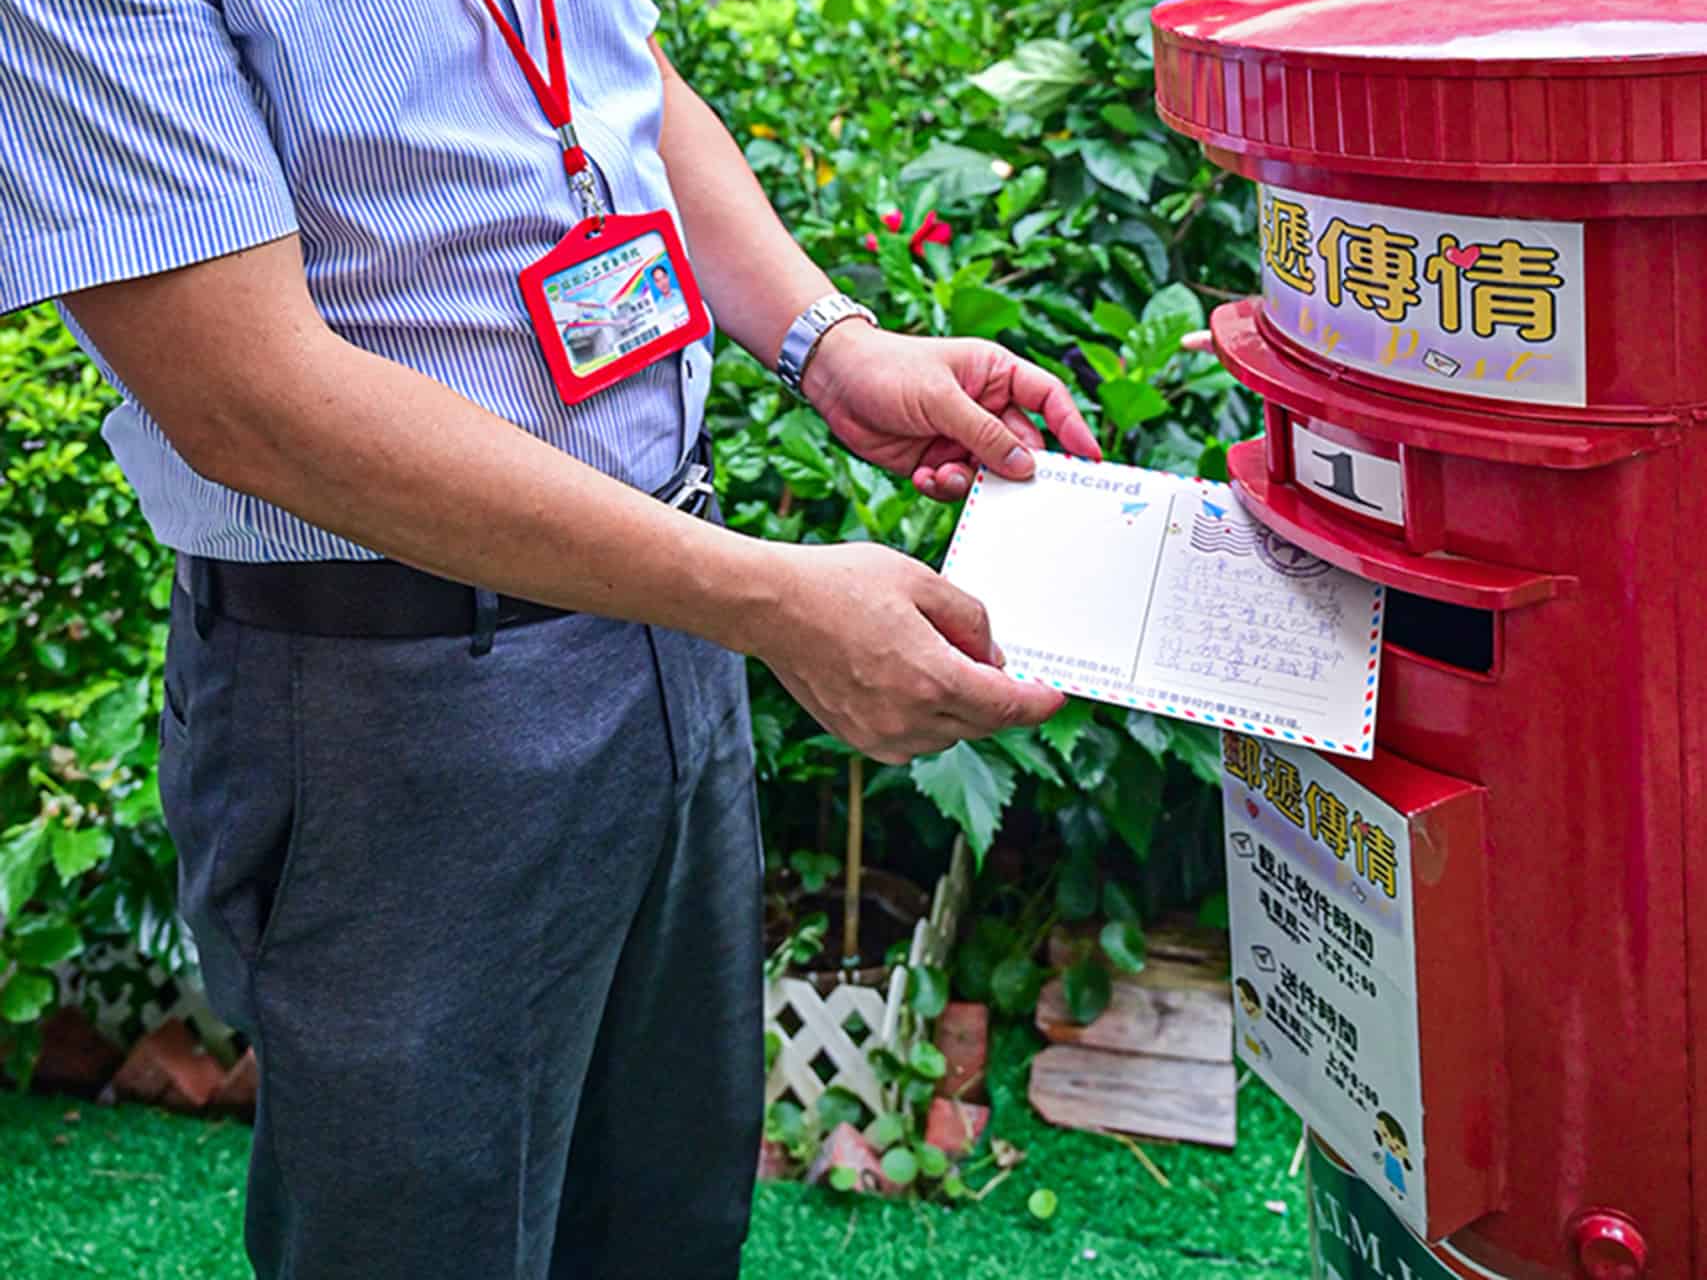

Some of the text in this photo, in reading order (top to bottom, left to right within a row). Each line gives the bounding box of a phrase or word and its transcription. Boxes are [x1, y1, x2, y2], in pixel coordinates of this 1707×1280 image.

[1262, 195, 1565, 342] 遞傳情
[1038, 467, 1143, 497] ostcard
[1312, 450, 1384, 511] 1
